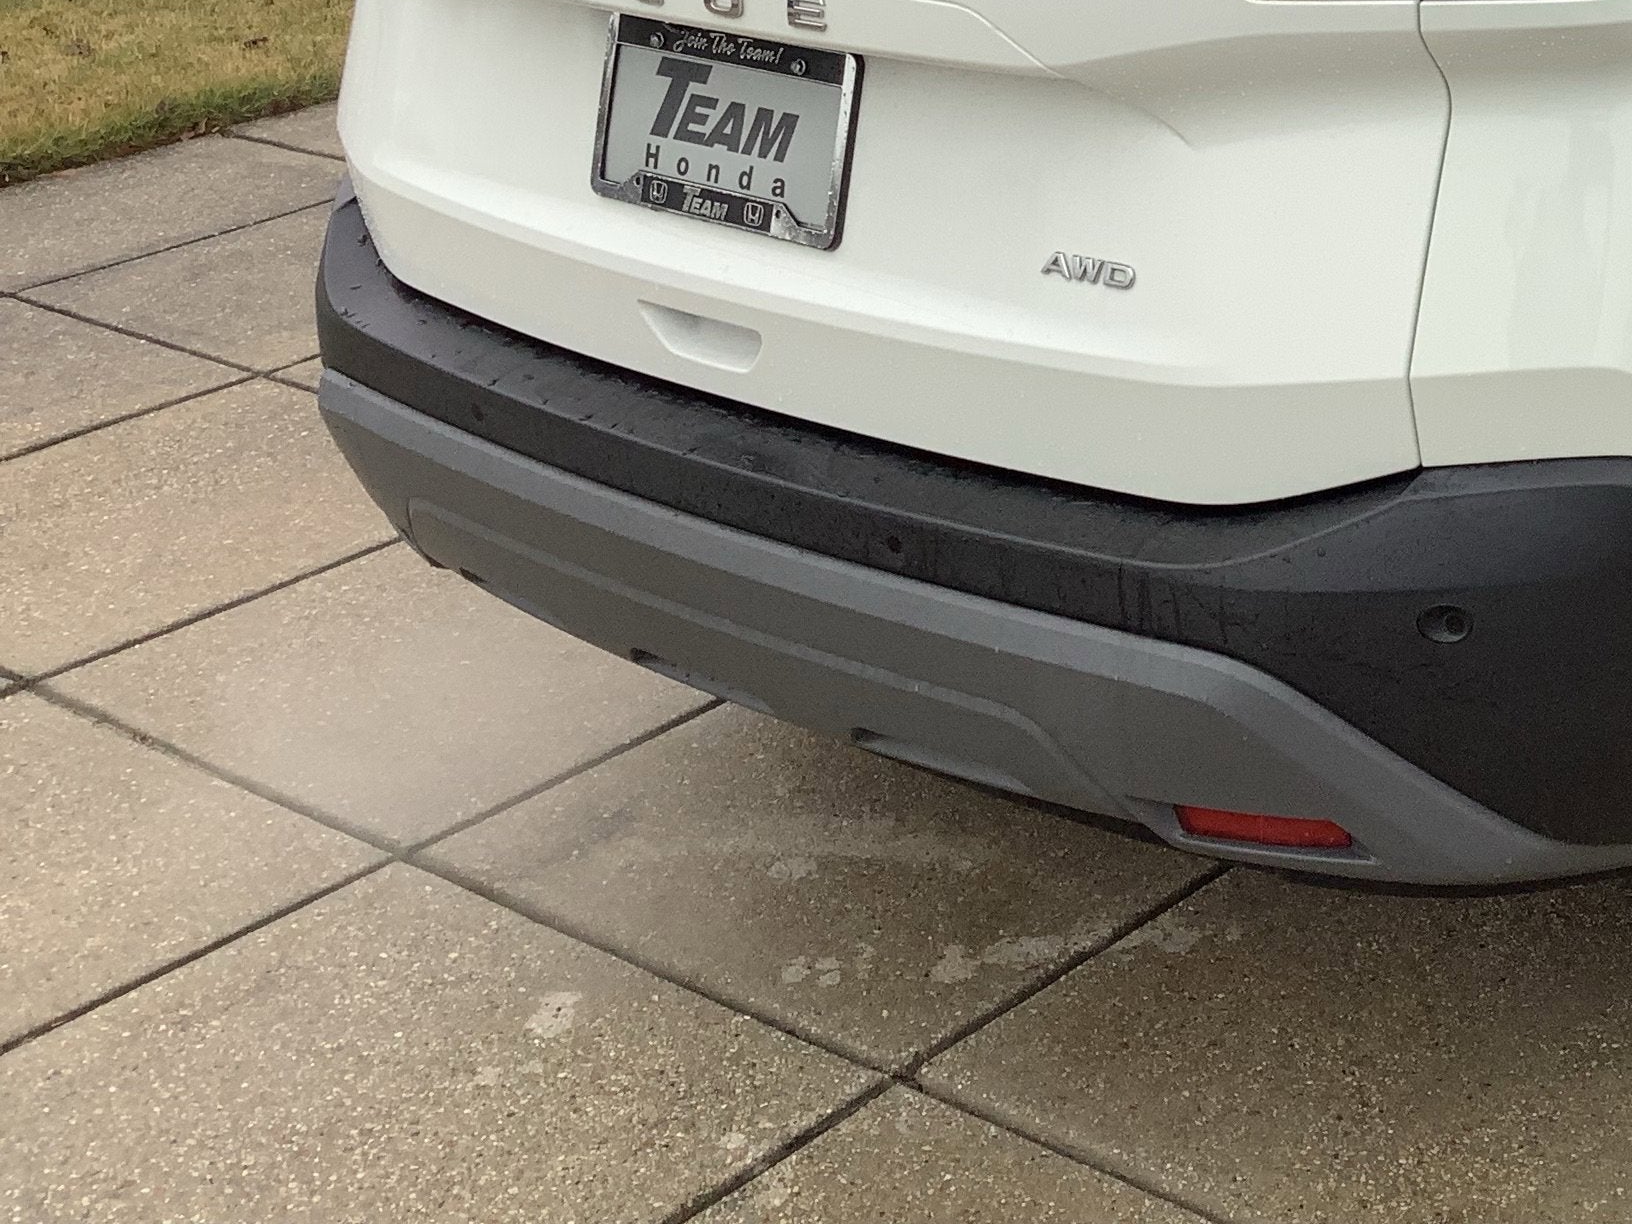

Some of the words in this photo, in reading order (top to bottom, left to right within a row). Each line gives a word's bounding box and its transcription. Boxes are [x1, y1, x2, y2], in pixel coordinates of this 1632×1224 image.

[673, 31, 708, 52] Join
[709, 33, 737, 56] The
[737, 38, 785, 65] Team!
[649, 57, 800, 163] TEAM
[645, 143, 786, 199] Honda
[682, 185, 730, 221] TEAM
[1040, 251, 1137, 290] AWD
